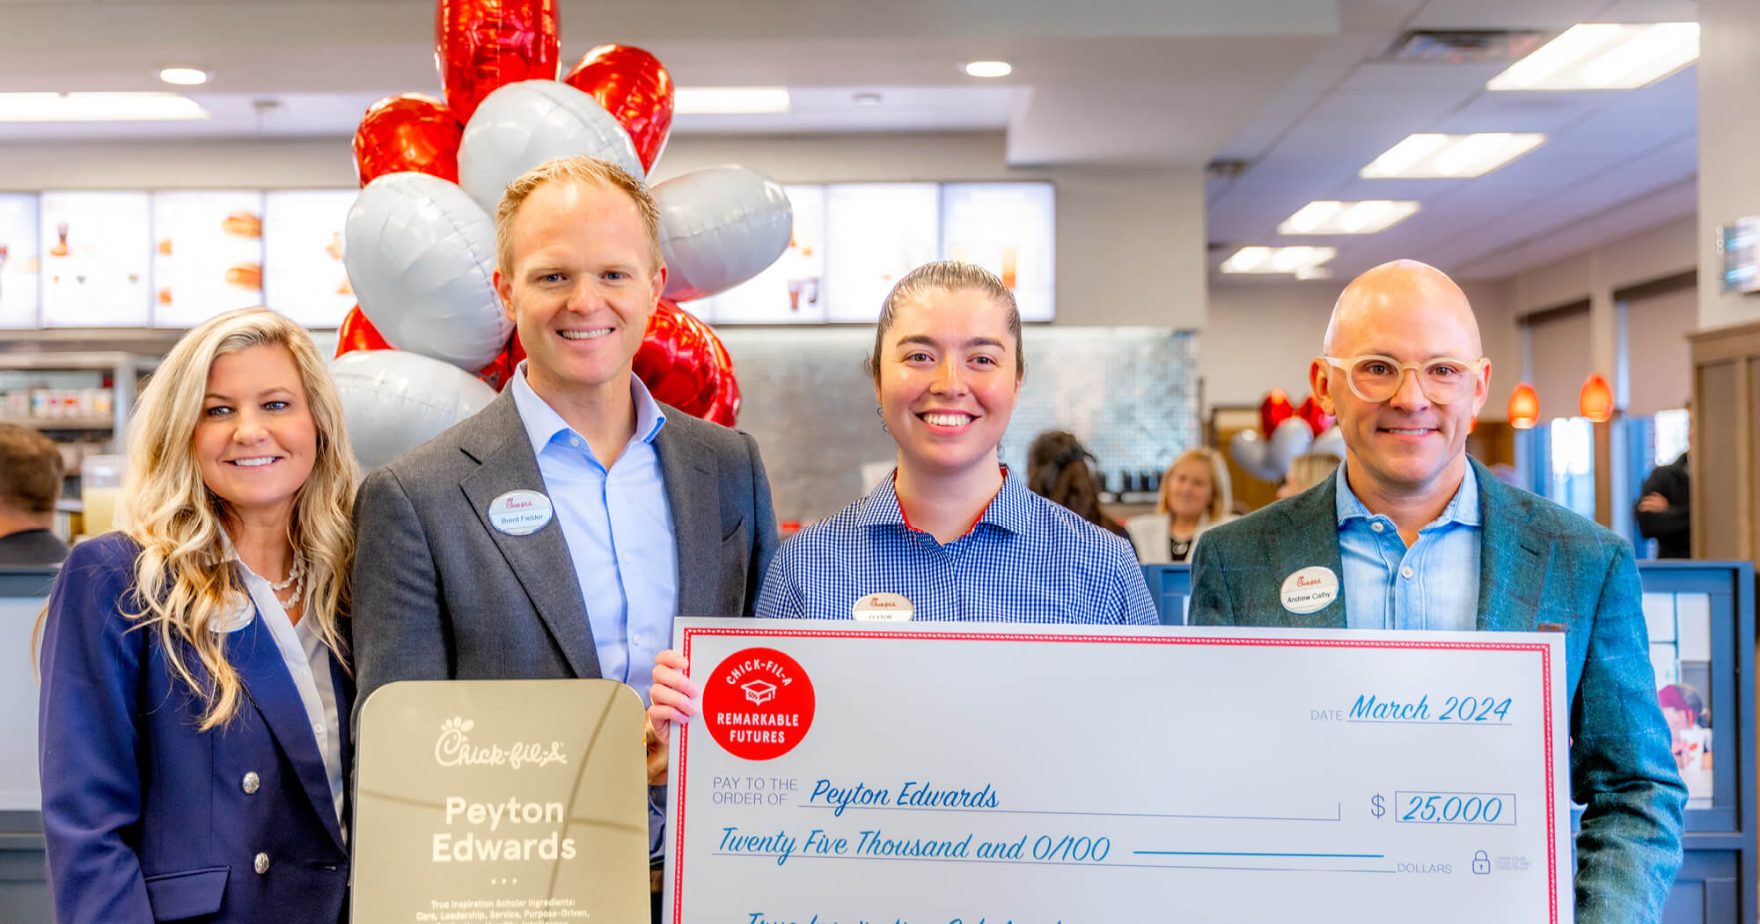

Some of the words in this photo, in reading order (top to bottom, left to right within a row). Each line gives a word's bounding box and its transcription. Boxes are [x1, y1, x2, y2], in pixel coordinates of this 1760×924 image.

[1287, 595, 1311, 603] Andrew
[726, 659, 793, 686] CHICK-FIL-A
[1310, 709, 1344, 721] DATE
[1348, 694, 1431, 721] March
[1439, 696, 1513, 722] 2024
[717, 712, 799, 727] REMARKABLE
[729, 730, 785, 743] FUTURES
[713, 777, 741, 790] PAY
[745, 777, 766, 791] TO
[770, 778, 798, 792] THE
[712, 791, 762, 805] ORDER
[767, 792, 788, 806] OF
[810, 779, 891, 817] Peyton
[896, 781, 1000, 809] Edwards
[446, 796, 564, 831] Peyton
[1371, 793, 1386, 819] $
[1402, 795, 1502, 824] 25,000
[432, 832, 577, 862] Edwards
[719, 827, 797, 866] Twenty
[803, 828, 849, 855] Five
[856, 829, 974, 860] Thousand
[976, 834, 1025, 861] and
[1032, 836, 1111, 862] 0/100
[1397, 862, 1453, 875] DOLLARS
[431, 900, 449, 909] True
[451, 899, 494, 910] Inspiration
[496, 898, 526, 908] Scholar
[416, 911, 438, 922] Care,
[440, 910, 488, 921] Leadership,
[524, 908, 590, 920] Purpose-Driven,
